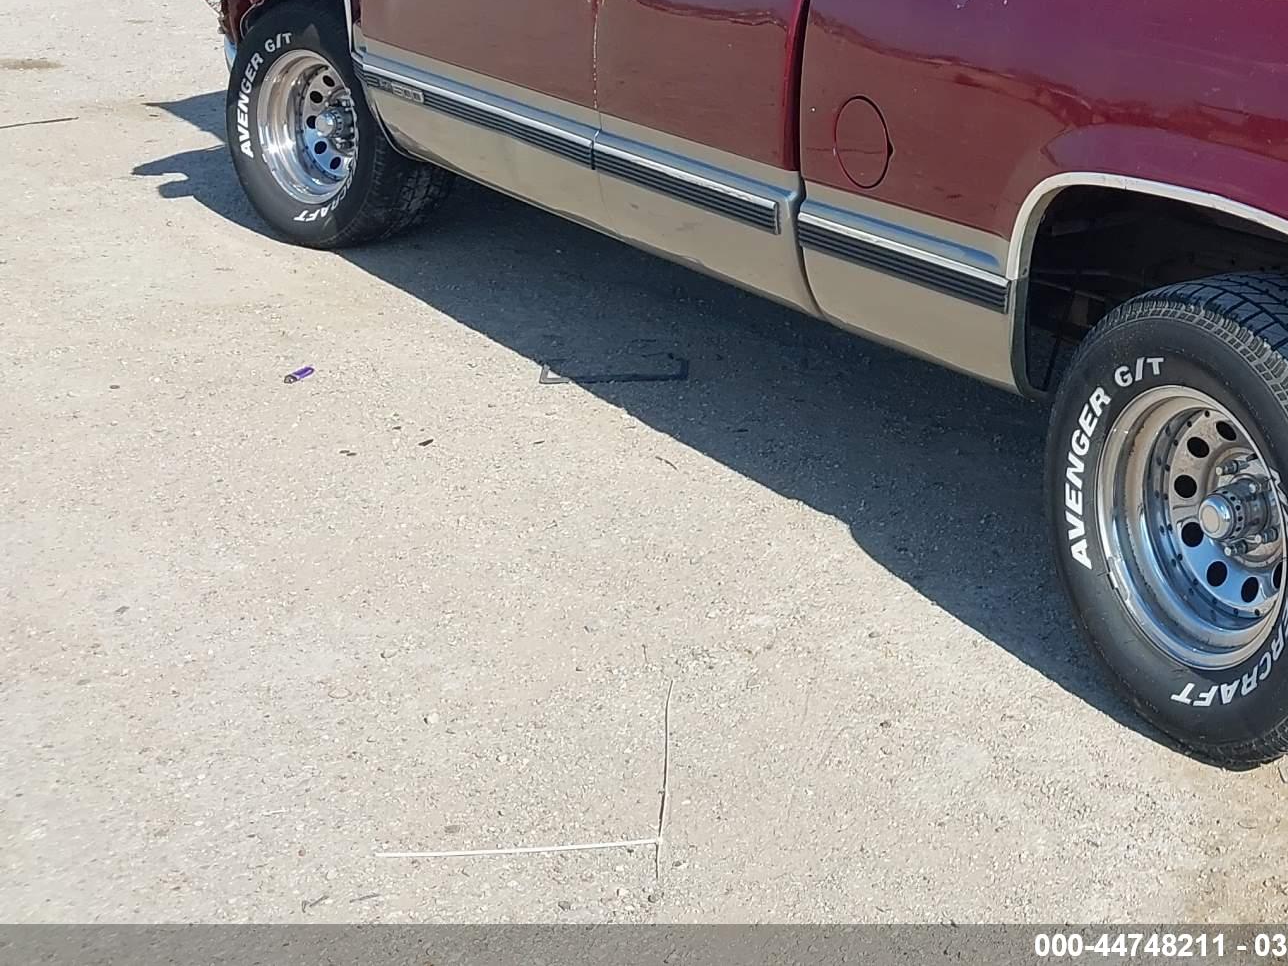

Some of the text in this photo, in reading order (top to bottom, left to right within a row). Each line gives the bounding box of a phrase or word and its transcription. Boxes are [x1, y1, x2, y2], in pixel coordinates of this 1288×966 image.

[236, 32, 292, 158] AVENGER G/T
[1065, 357, 1164, 570] AVENGER G/T
